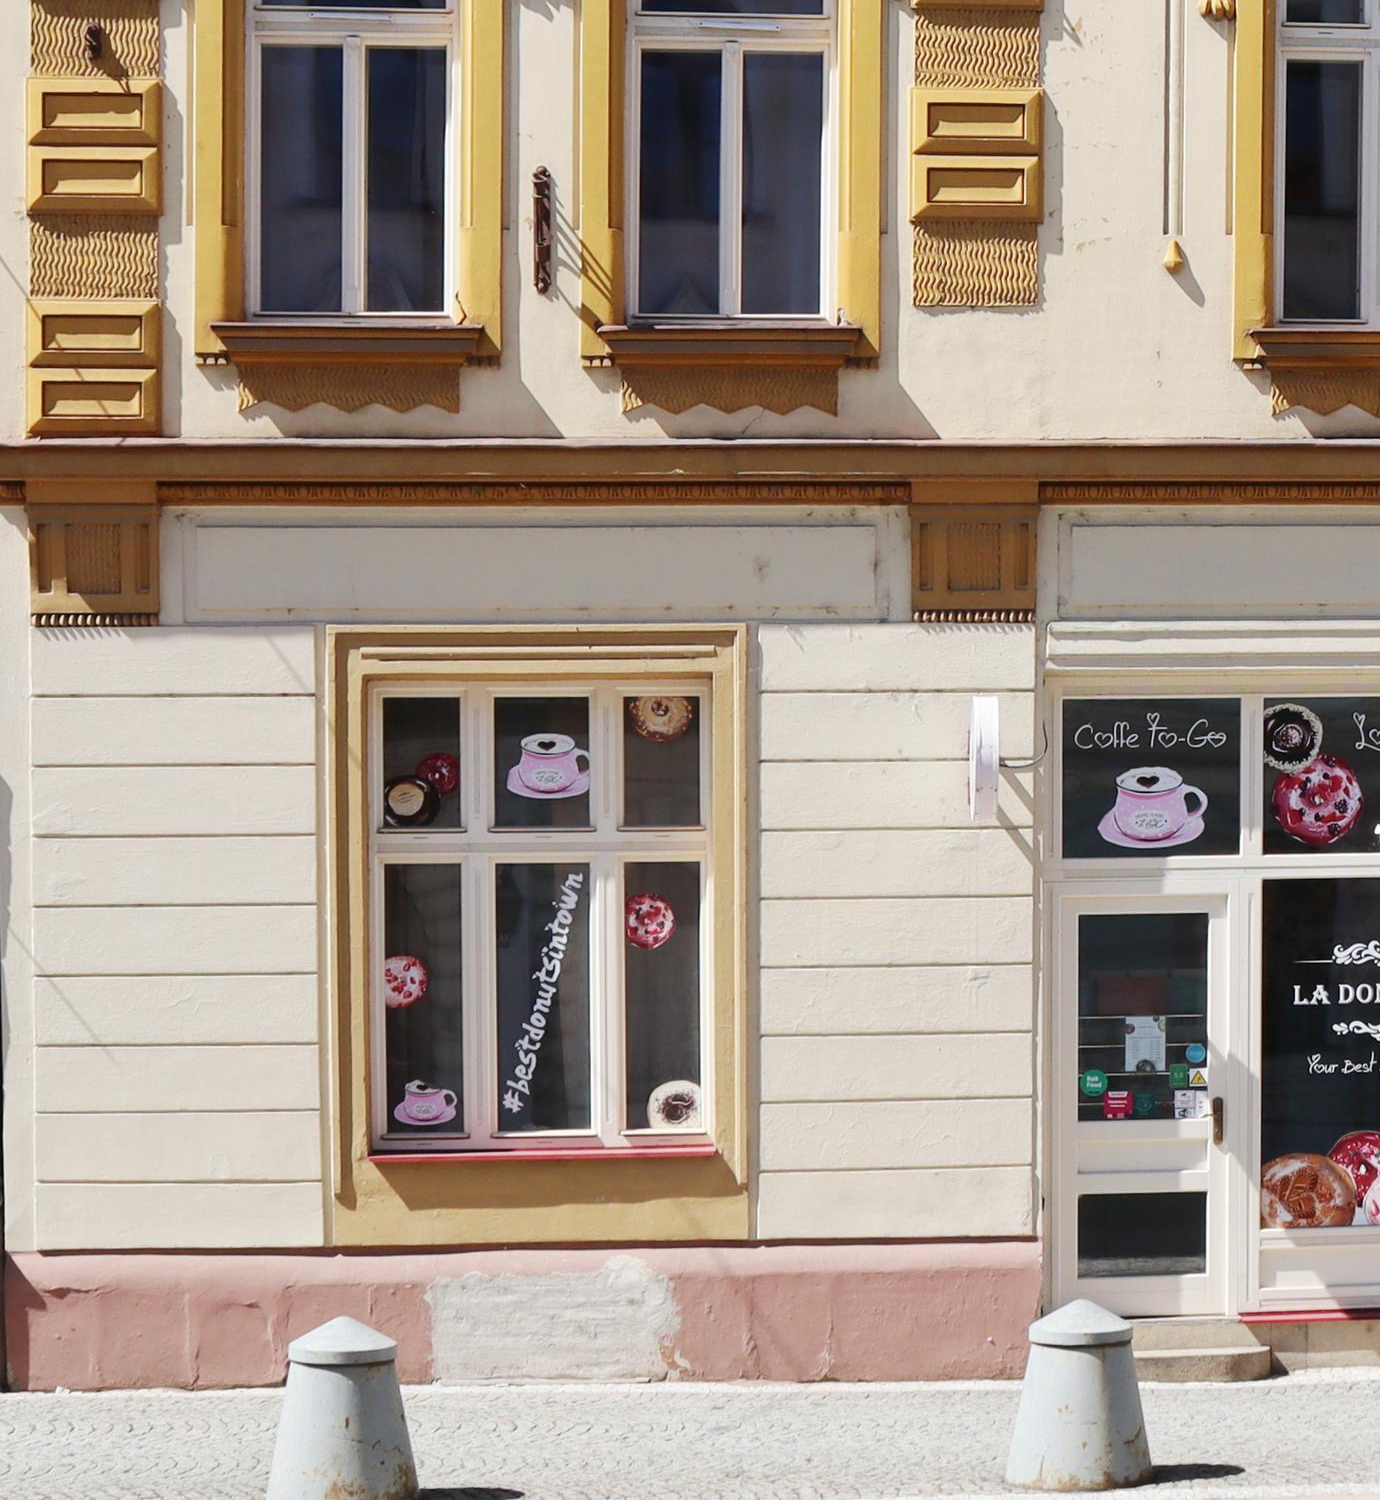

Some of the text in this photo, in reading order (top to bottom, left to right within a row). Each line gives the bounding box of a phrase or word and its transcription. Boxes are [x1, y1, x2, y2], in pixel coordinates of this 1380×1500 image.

[1074, 712, 1227, 749] Coffe To-Go
[502, 872, 584, 1114] #bestdonutsintown
[1293, 984, 1331, 1005] LA
[1307, 1053, 1339, 1074] Your
[1341, 1051, 1378, 1075] Best
